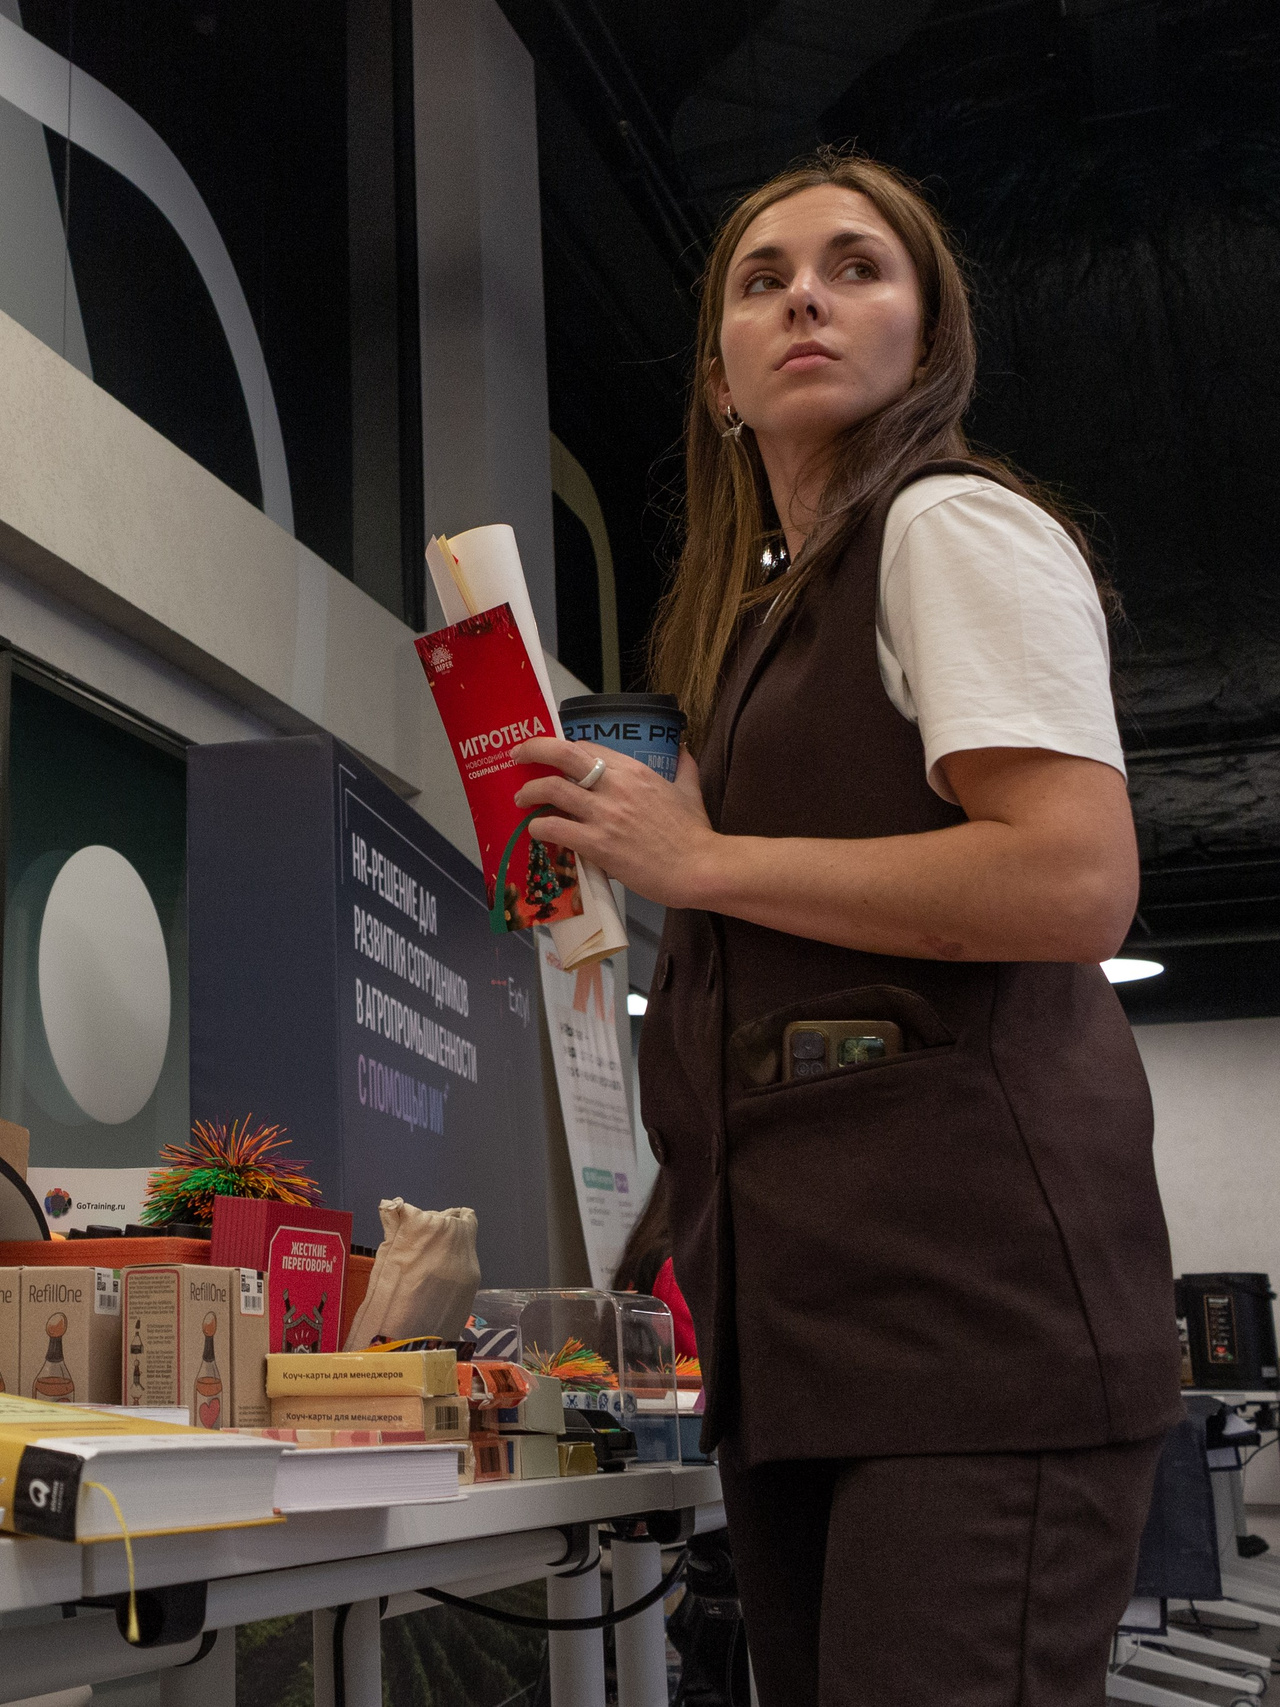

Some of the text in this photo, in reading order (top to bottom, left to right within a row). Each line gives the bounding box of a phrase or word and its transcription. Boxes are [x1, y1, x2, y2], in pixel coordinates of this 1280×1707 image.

[459, 716, 546, 759] ИГРОТЕКА
[468, 765, 500, 780] СОБИРАЕМ
[352, 832, 437, 936] HR-РЕШЕНИЕ ДЛЯ
[354, 904, 407, 979] РАЗВИТИЯ
[76, 1202, 126, 1211] GoTraining.ru
[290, 1241, 327, 1258] ЖЕСТКИЕ
[29, 1284, 82, 1303] RefillOne
[190, 1282, 226, 1303] RefillOne
[282, 1371, 403, 1380] Коуч-карты для менеджеров
[286, 1412, 403, 1422] Коуч-карты для менеджеров
